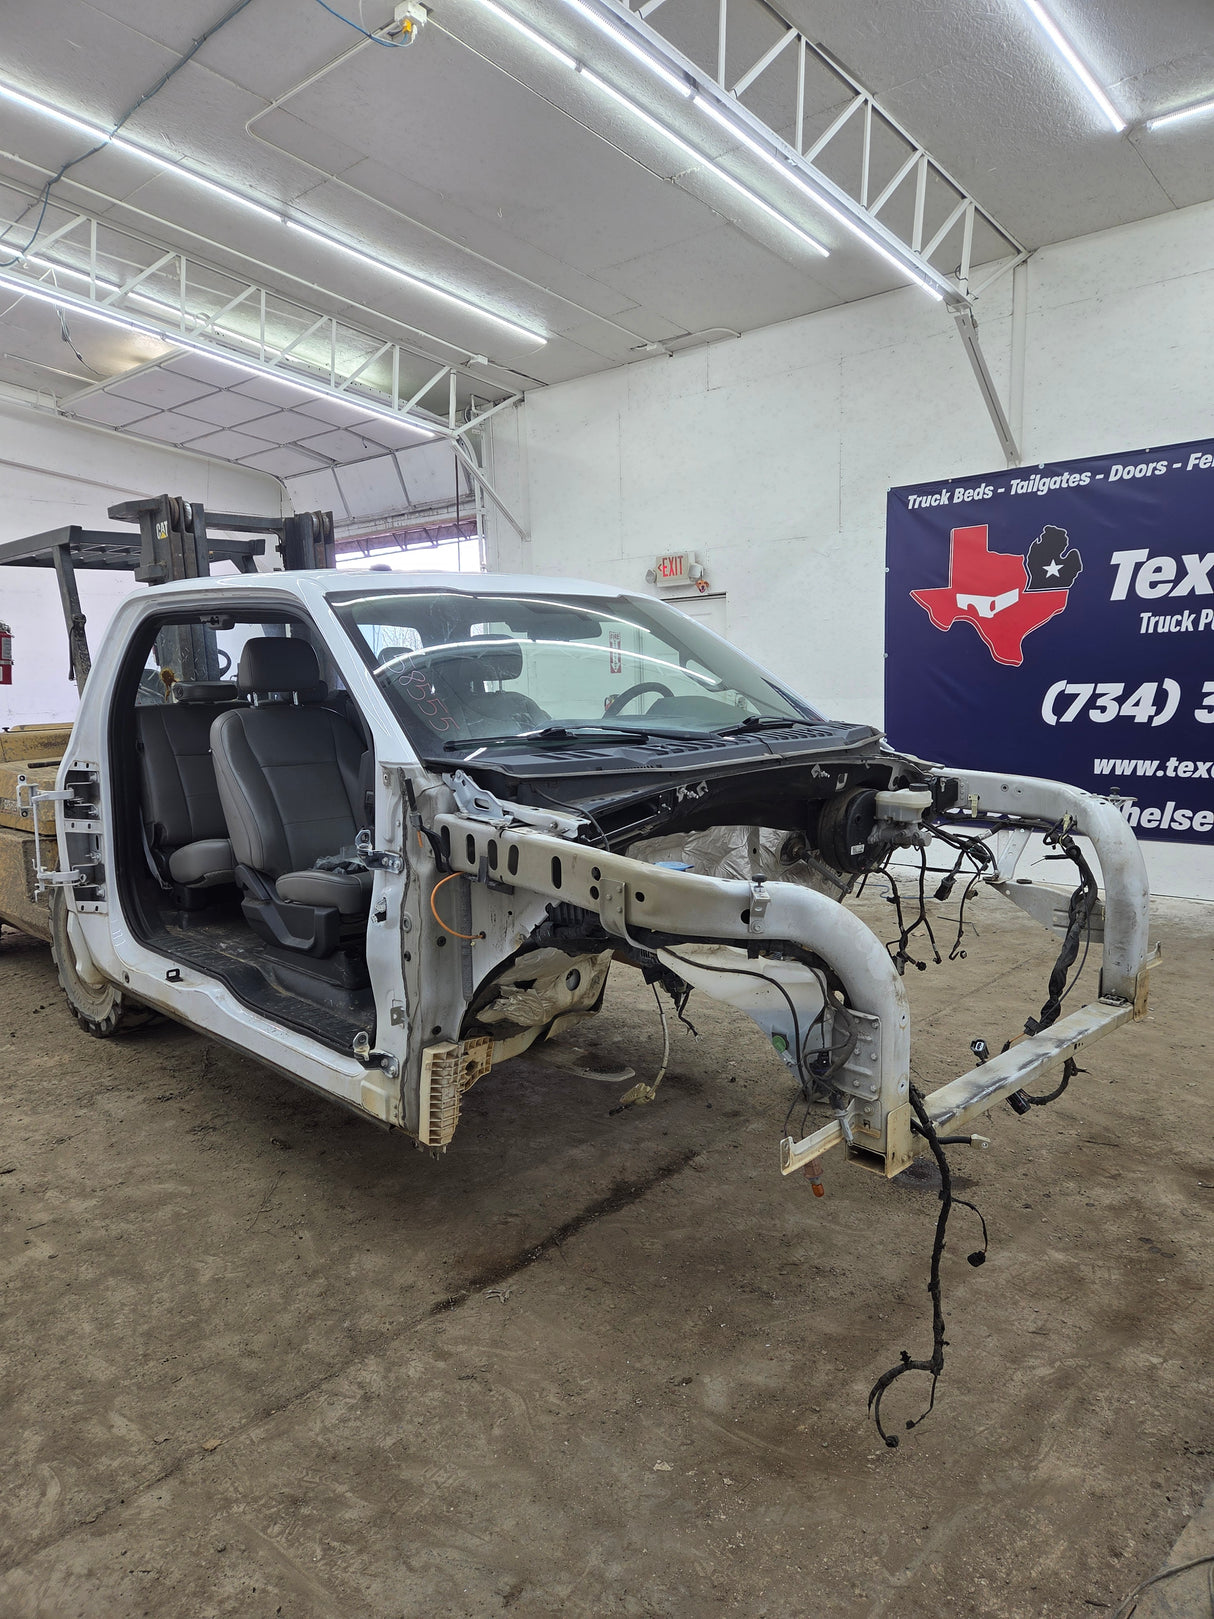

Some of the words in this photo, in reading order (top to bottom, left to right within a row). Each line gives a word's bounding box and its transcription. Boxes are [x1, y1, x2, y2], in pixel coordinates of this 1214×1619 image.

[907, 488, 950, 509] Truck
[953, 483, 994, 503] Beds
[1010, 471, 1092, 495] Tailgates
[1108, 460, 1168, 482] Doors
[1186, 452, 1214, 471] Fe
[156, 520, 168, 539] CAT
[662, 555, 684, 577] EXIT
[1110, 548, 1214, 601] Tex
[1140, 610, 1197, 634] Truck
[1198, 608, 1214, 631] P
[382, 652, 460, 731] 58555
[1041, 678, 1181, 727] (734)
[1093, 757, 1214, 779] www.tex
[1119, 800, 1214, 832] helse
